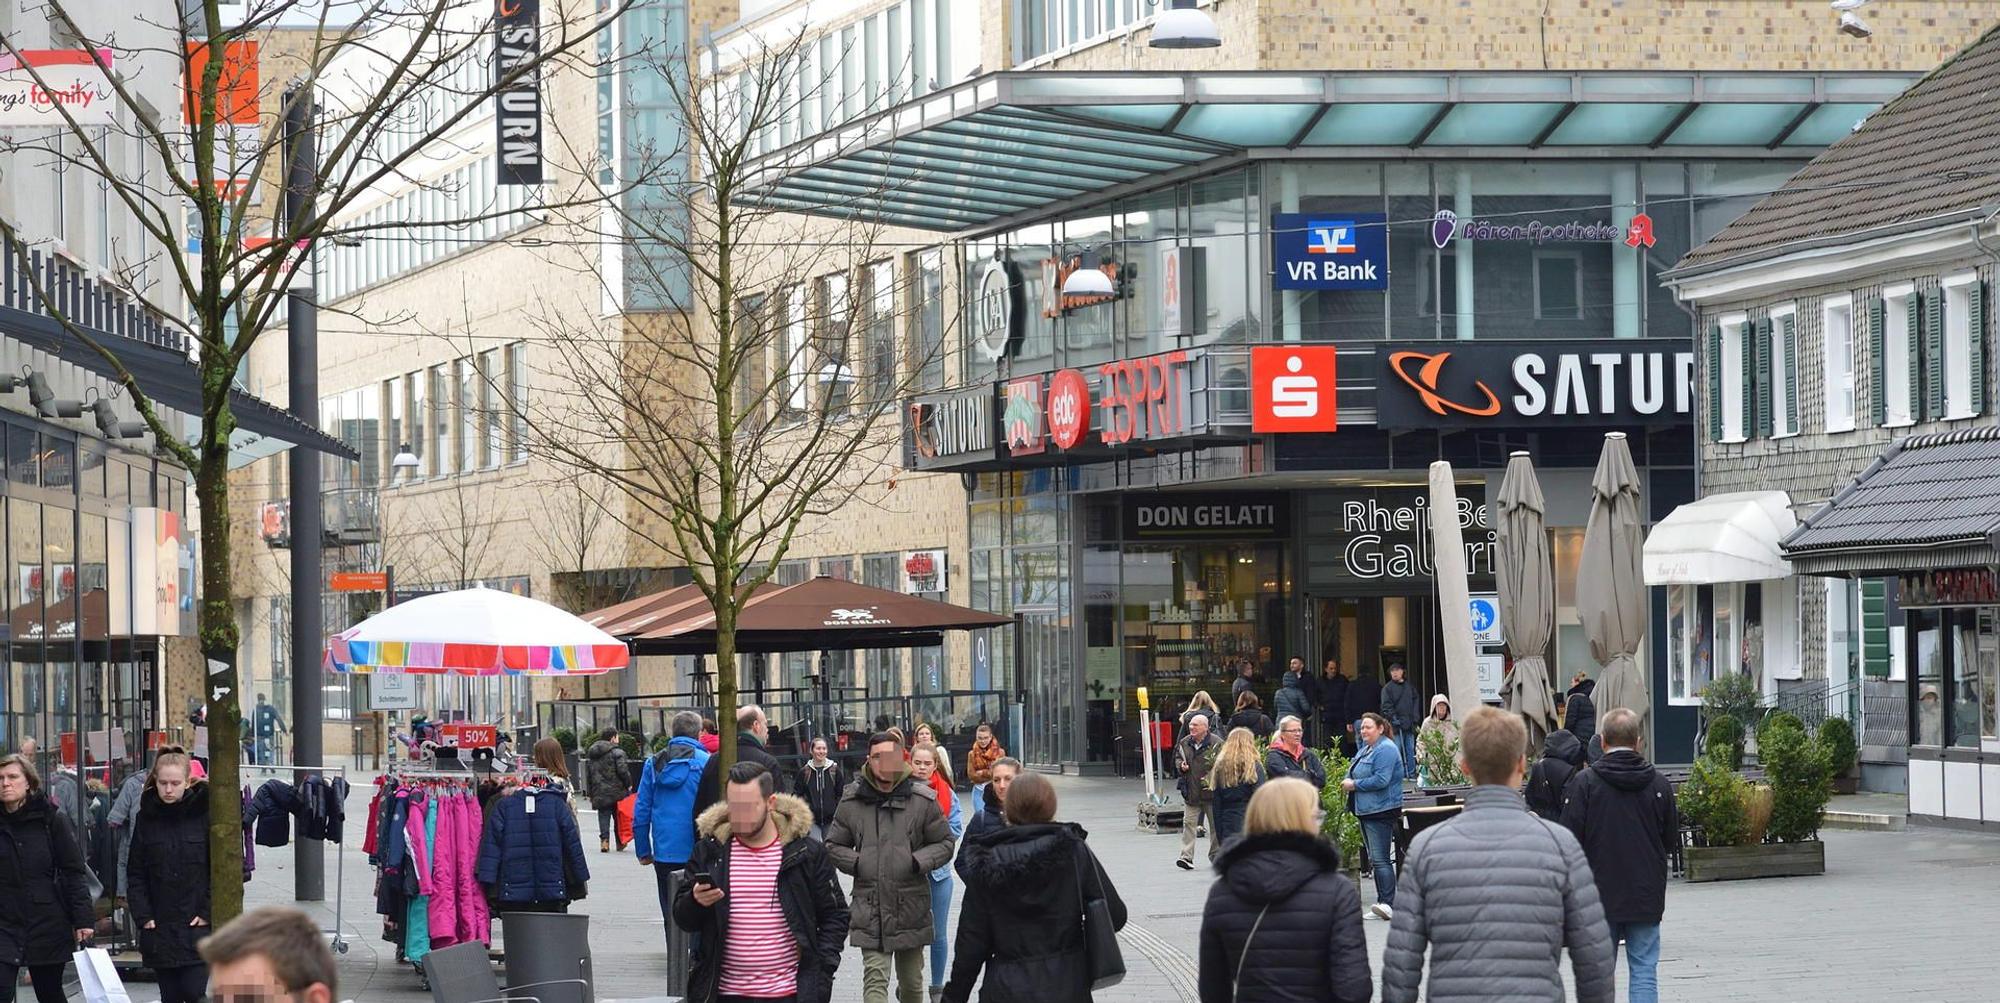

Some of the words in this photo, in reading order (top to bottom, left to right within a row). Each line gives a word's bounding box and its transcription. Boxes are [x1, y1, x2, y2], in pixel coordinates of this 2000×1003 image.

[31, 84, 94, 108] family
[1462, 220, 1620, 244] Bären-Apotheke
[1286, 261, 1317, 280] VR
[1324, 260, 1377, 280] Bank
[1100, 350, 1187, 443] ESPRIT
[1512, 353, 1695, 416] SATUR
[1053, 386, 1075, 426] edc
[934, 395, 986, 457] SATURN
[1137, 506, 1188, 526] DON
[1194, 505, 1274, 525] GELATI
[465, 730, 489, 743] 50%
